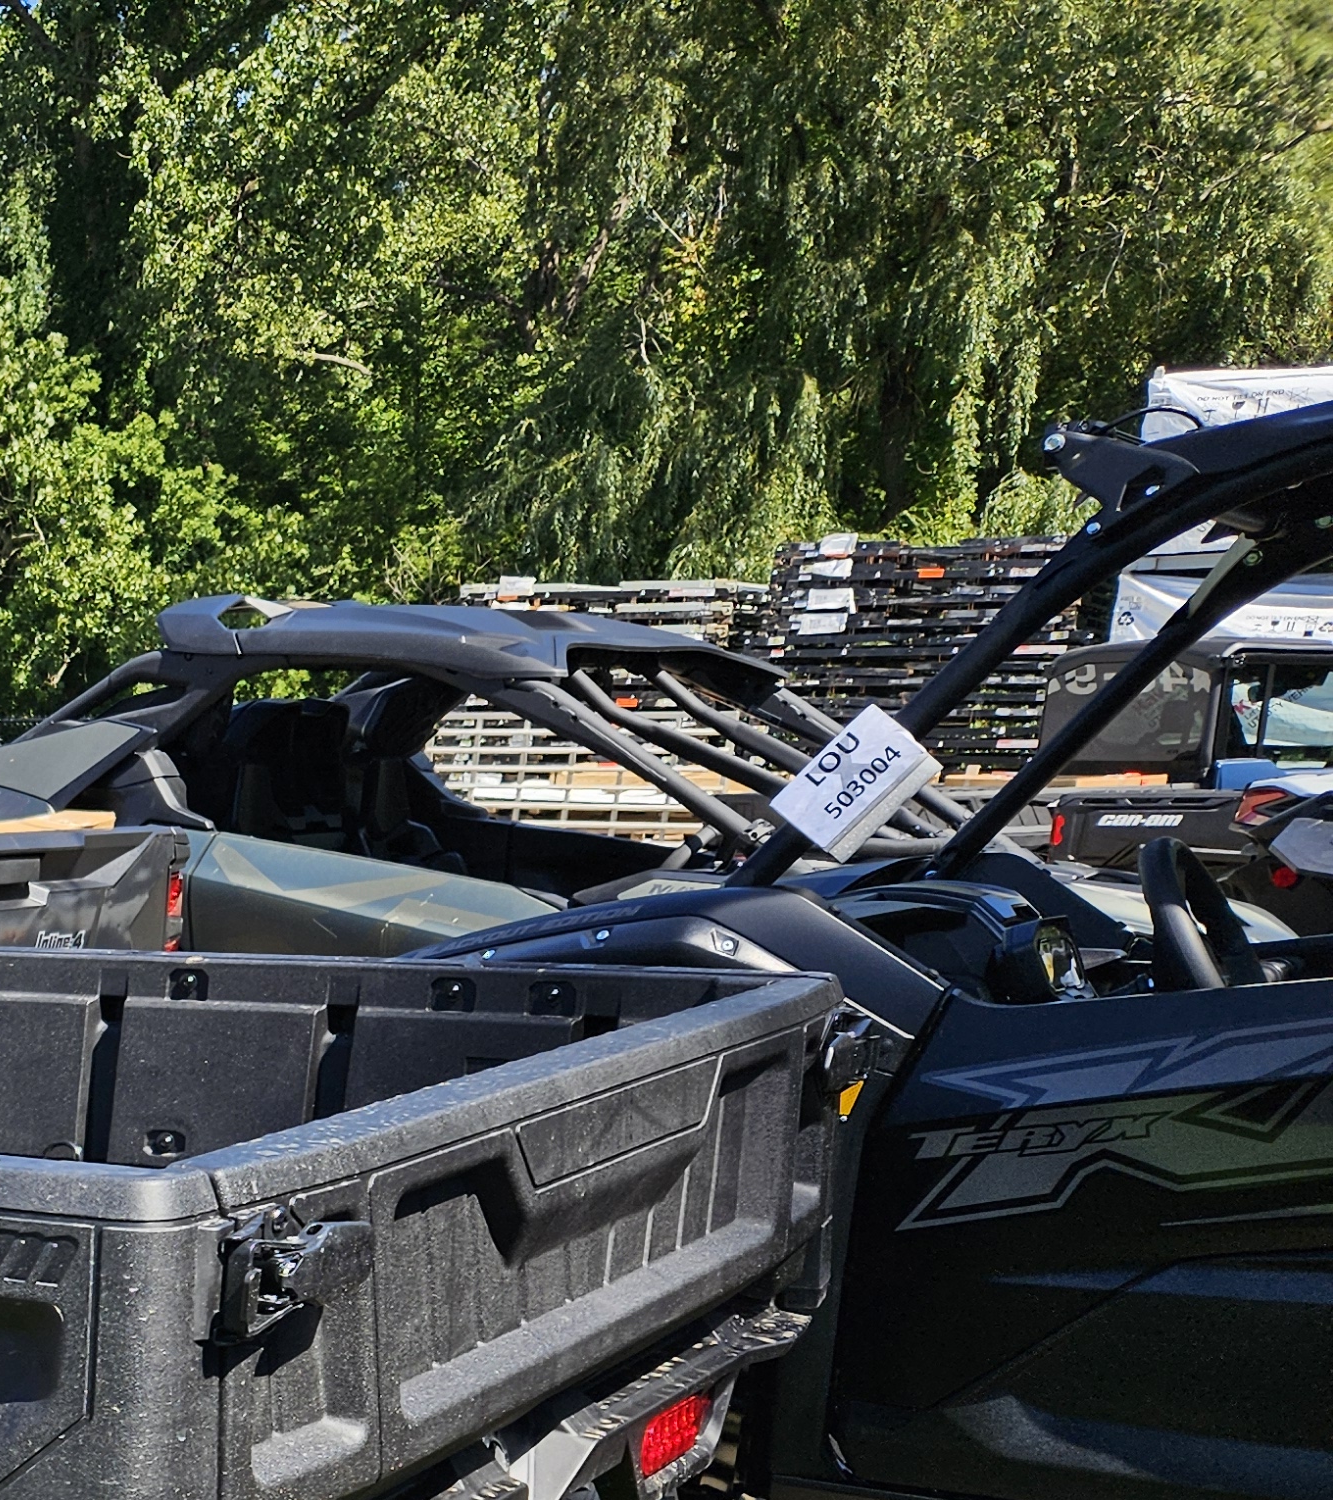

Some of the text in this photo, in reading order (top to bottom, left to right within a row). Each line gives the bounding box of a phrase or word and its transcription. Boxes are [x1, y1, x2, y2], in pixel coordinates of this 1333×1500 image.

[804, 731, 860, 787] LOU
[824, 745, 903, 820] 503004
[1097, 814, 1184, 827] can-am
